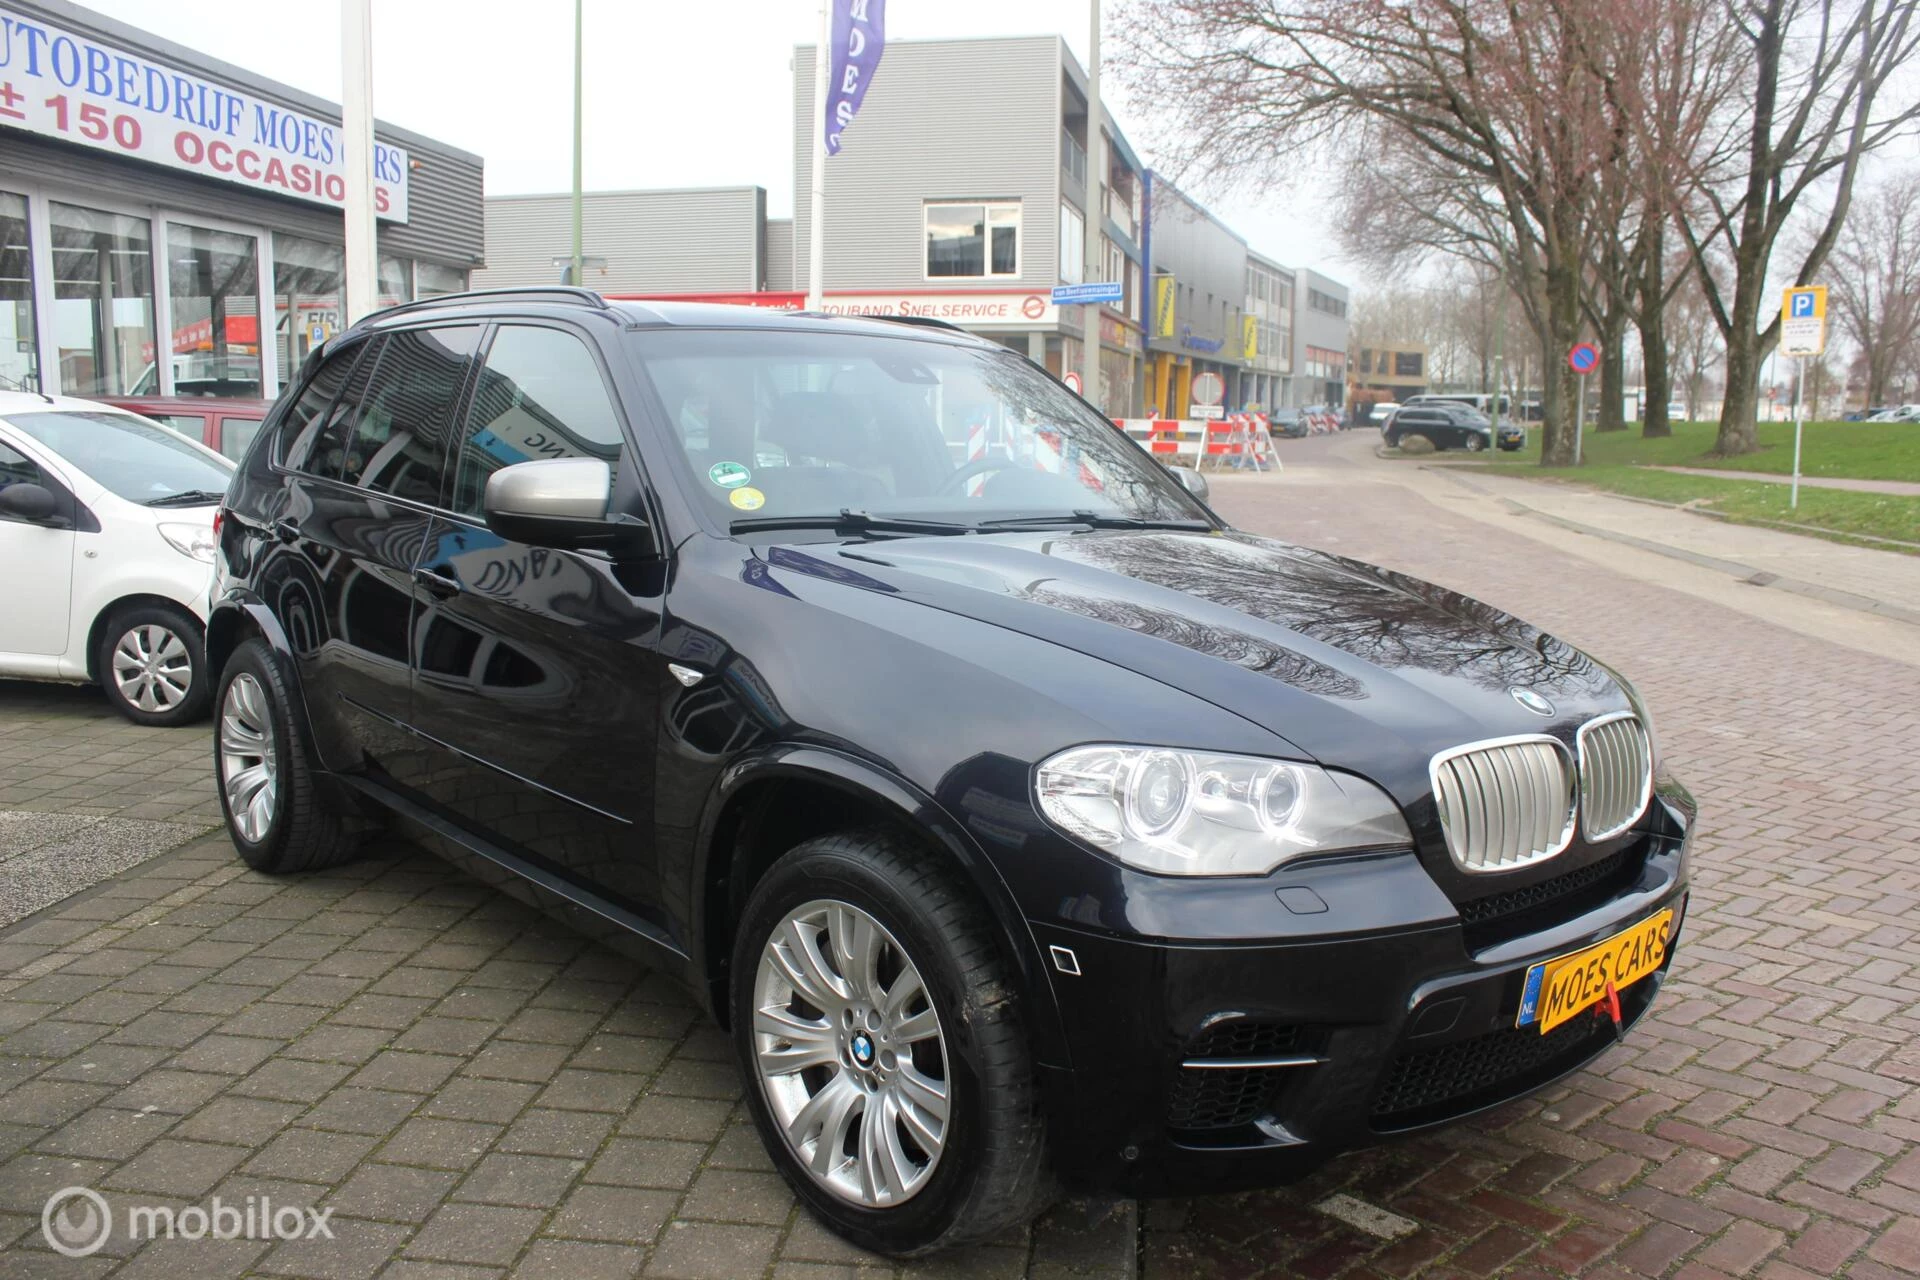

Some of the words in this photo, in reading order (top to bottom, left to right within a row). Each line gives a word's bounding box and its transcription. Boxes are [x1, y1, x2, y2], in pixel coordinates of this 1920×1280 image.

[45, 94, 142, 150] 150
[174, 131, 390, 213] OCCASIOS
[253, 103, 334, 165] MOES
[341, 142, 402, 184] RS
[1796, 295, 1810, 316] P
[1522, 1003, 1535, 1016] NL
[1545, 951, 1612, 1023] MOES
[1614, 920, 1669, 982] CARS
